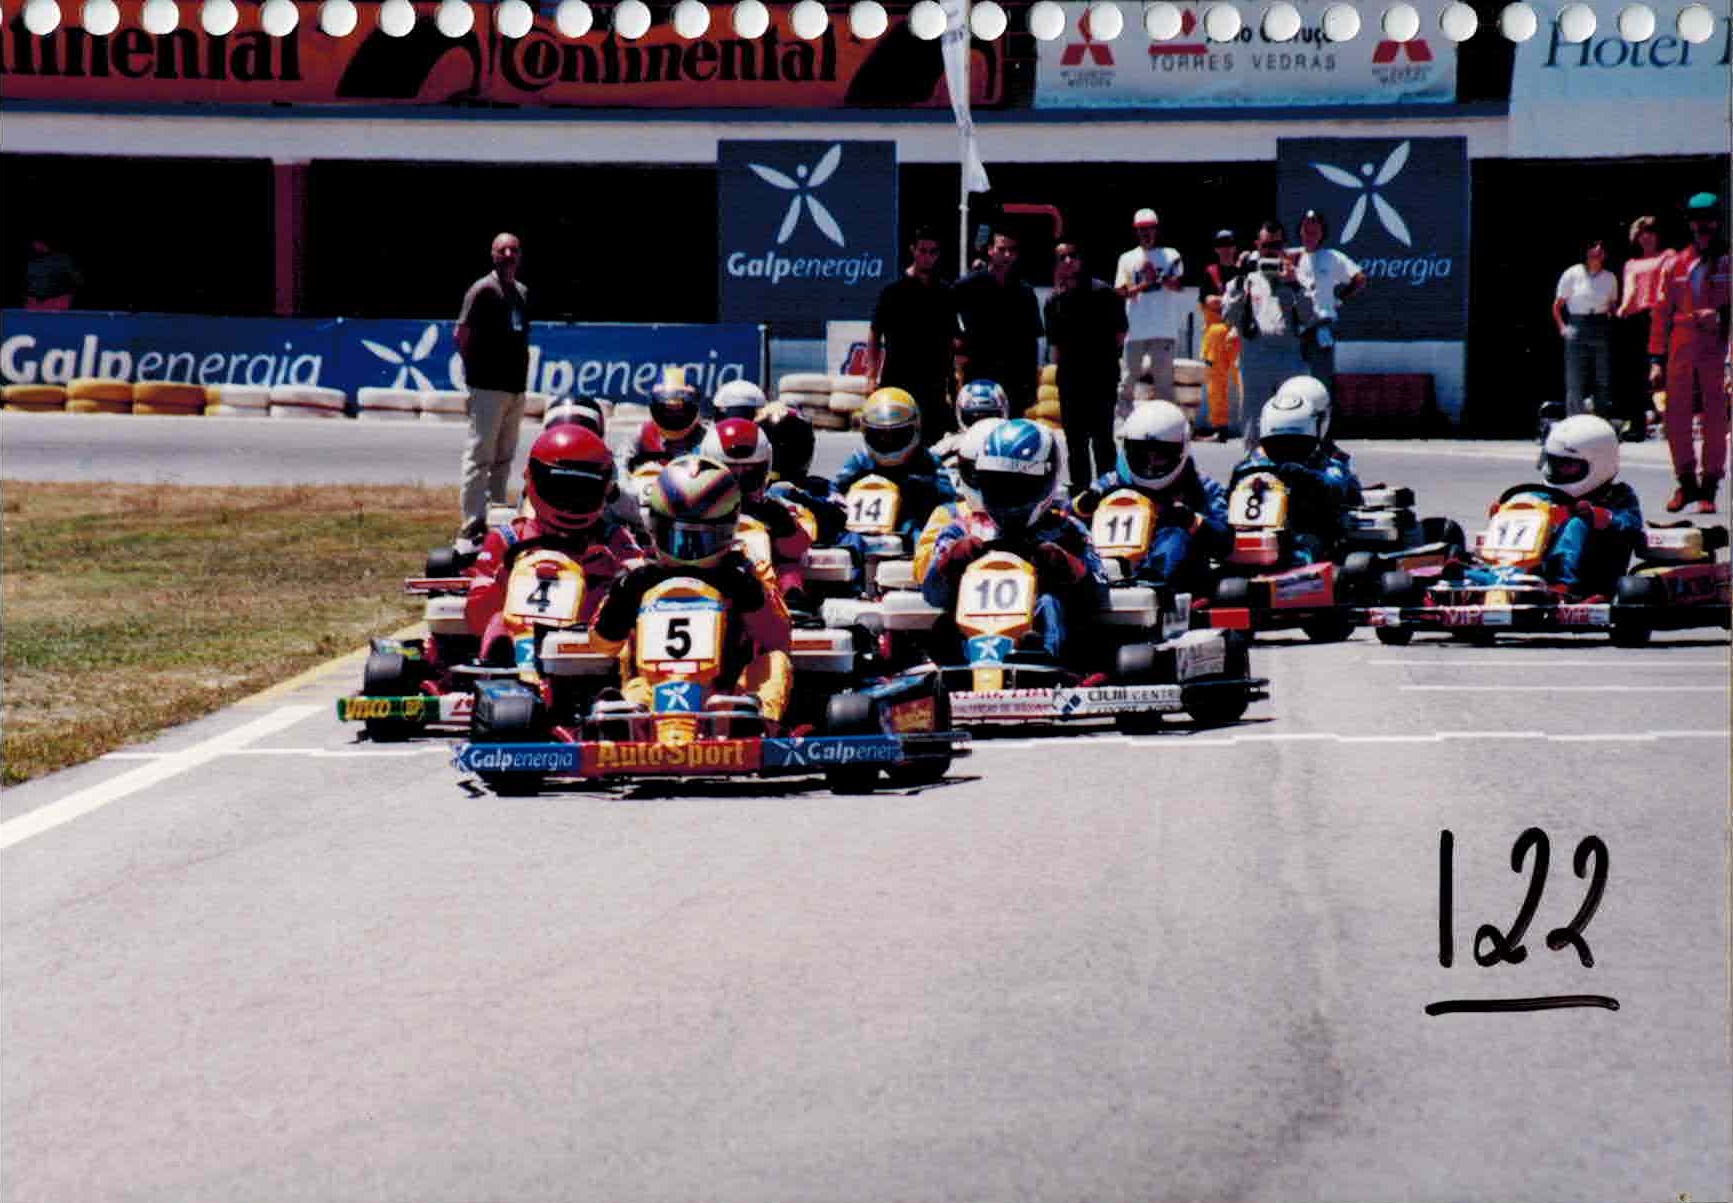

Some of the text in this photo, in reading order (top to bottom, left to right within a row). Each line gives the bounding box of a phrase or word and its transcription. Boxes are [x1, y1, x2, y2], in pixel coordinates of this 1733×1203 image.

[0, 10, 303, 82] tinental
[500, 22, 837, 92] Continental
[1151, 53, 1336, 72] TORRES VEDRAS
[727, 252, 884, 284] Galpenergia
[1356, 255, 1452, 286] energia
[449, 345, 744, 397] lpeneia
[852, 498, 882, 521] 14
[1245, 495, 1261, 520] 8
[1106, 516, 1134, 543] 11
[1499, 520, 1530, 546] 17
[526, 577, 554, 612] 4
[974, 578, 1018, 609] 10
[665, 618, 692, 659] 5
[470, 741, 900, 772] Galpenergia AutoSport Galpener
[1439, 827, 1609, 968] 122
